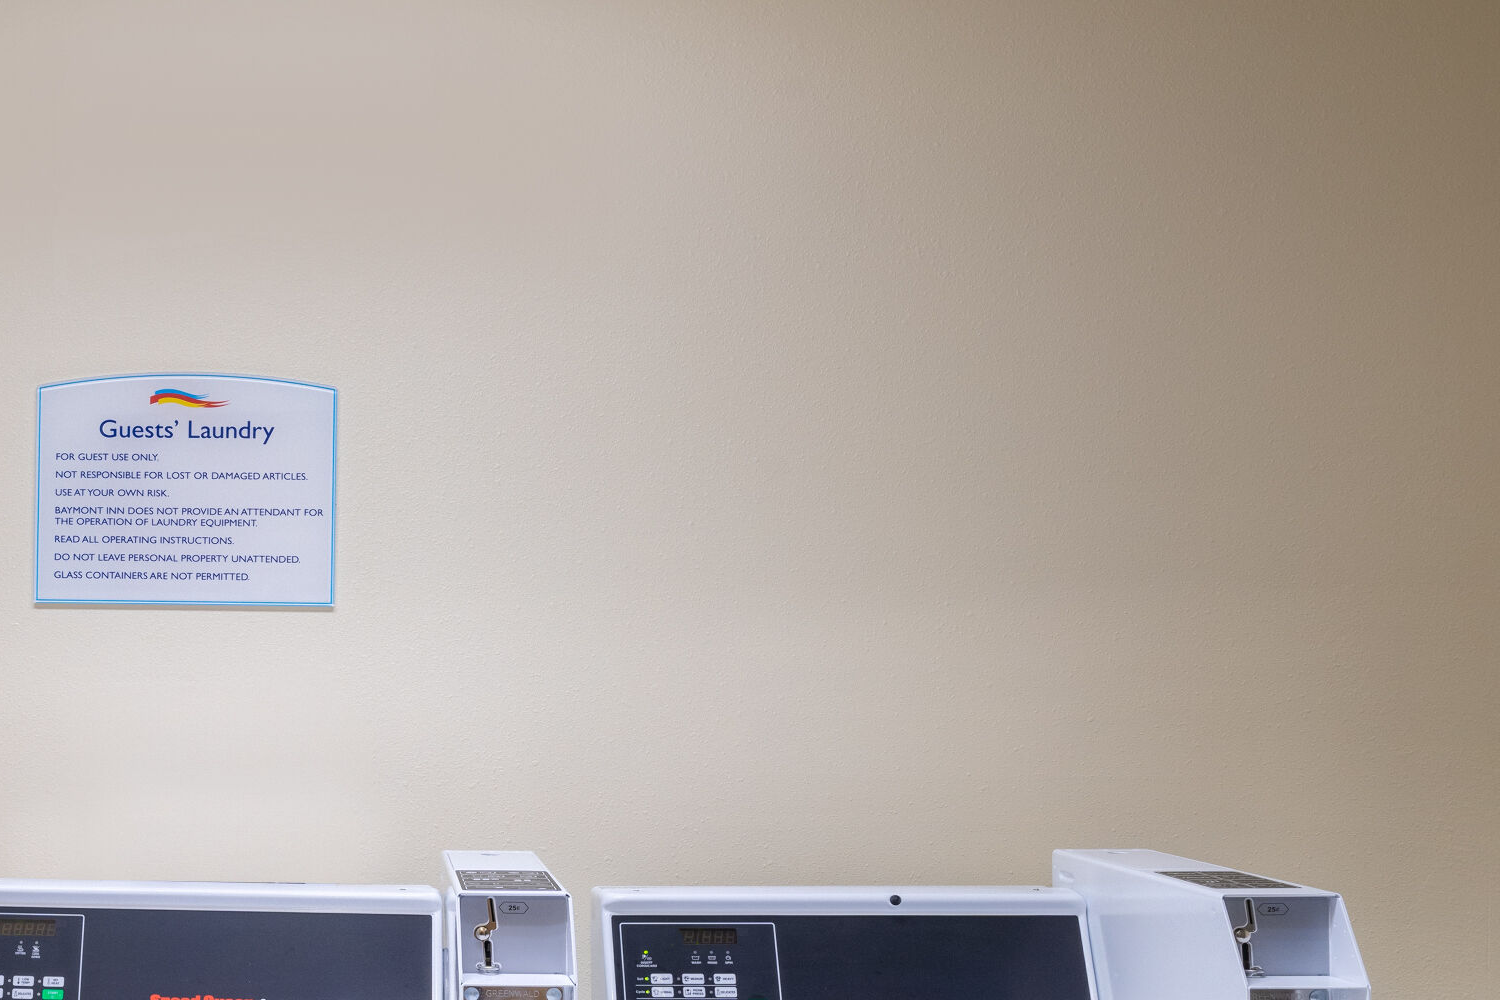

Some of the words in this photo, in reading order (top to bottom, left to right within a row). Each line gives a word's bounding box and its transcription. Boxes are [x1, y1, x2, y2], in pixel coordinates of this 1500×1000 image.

[99, 419, 178, 439] Guests’
[188, 420, 275, 444] Laundry
[55, 453, 75, 461] FOR
[78, 453, 108, 461] GUEST
[111, 453, 129, 461] USE
[55, 471, 77, 479] NOT
[80, 471, 141, 479] RESPONSIBLE
[144, 471, 164, 479] FOR
[166, 471, 191, 480] LOST
[194, 472, 209, 480] OR
[211, 472, 261, 480] DAMAGED
[262, 472, 308, 481] ARTICLES.
[87, 489, 115, 497] YOUR
[117, 489, 144, 497] OWN
[147, 489, 170, 497] RISK.
[55, 506, 104, 515] BAYMONT
[106, 507, 125, 515] INN
[128, 507, 154, 515] DOES
[156, 507, 179, 515] NOT
[182, 507, 223, 515] PROVIDE
[240, 508, 301, 516] ATTENDANT
[304, 509, 324, 517] FOR
[76, 518, 133, 526] OPERATION
[135, 518, 149, 526] OF
[151, 518, 198, 526] LAUNDRY
[200, 519, 258, 528] EQUIPMENT.
[54, 535, 80, 543] READ
[102, 536, 157, 544] OPERATING
[160, 536, 235, 545] INSTRUCTIONS.
[54, 553, 70, 561] DO
[73, 553, 95, 561] NOT
[128, 554, 178, 562] PERSONAL
[181, 554, 229, 562] PROPERTY
[231, 555, 301, 564] UNATTENDED.
[54, 571, 83, 579] GLASS
[85, 571, 148, 579] CONTAINERS
[171, 572, 193, 580] NOT
[196, 573, 250, 581] PERMITTED.
[485, 989, 540, 998] GREENWALD
